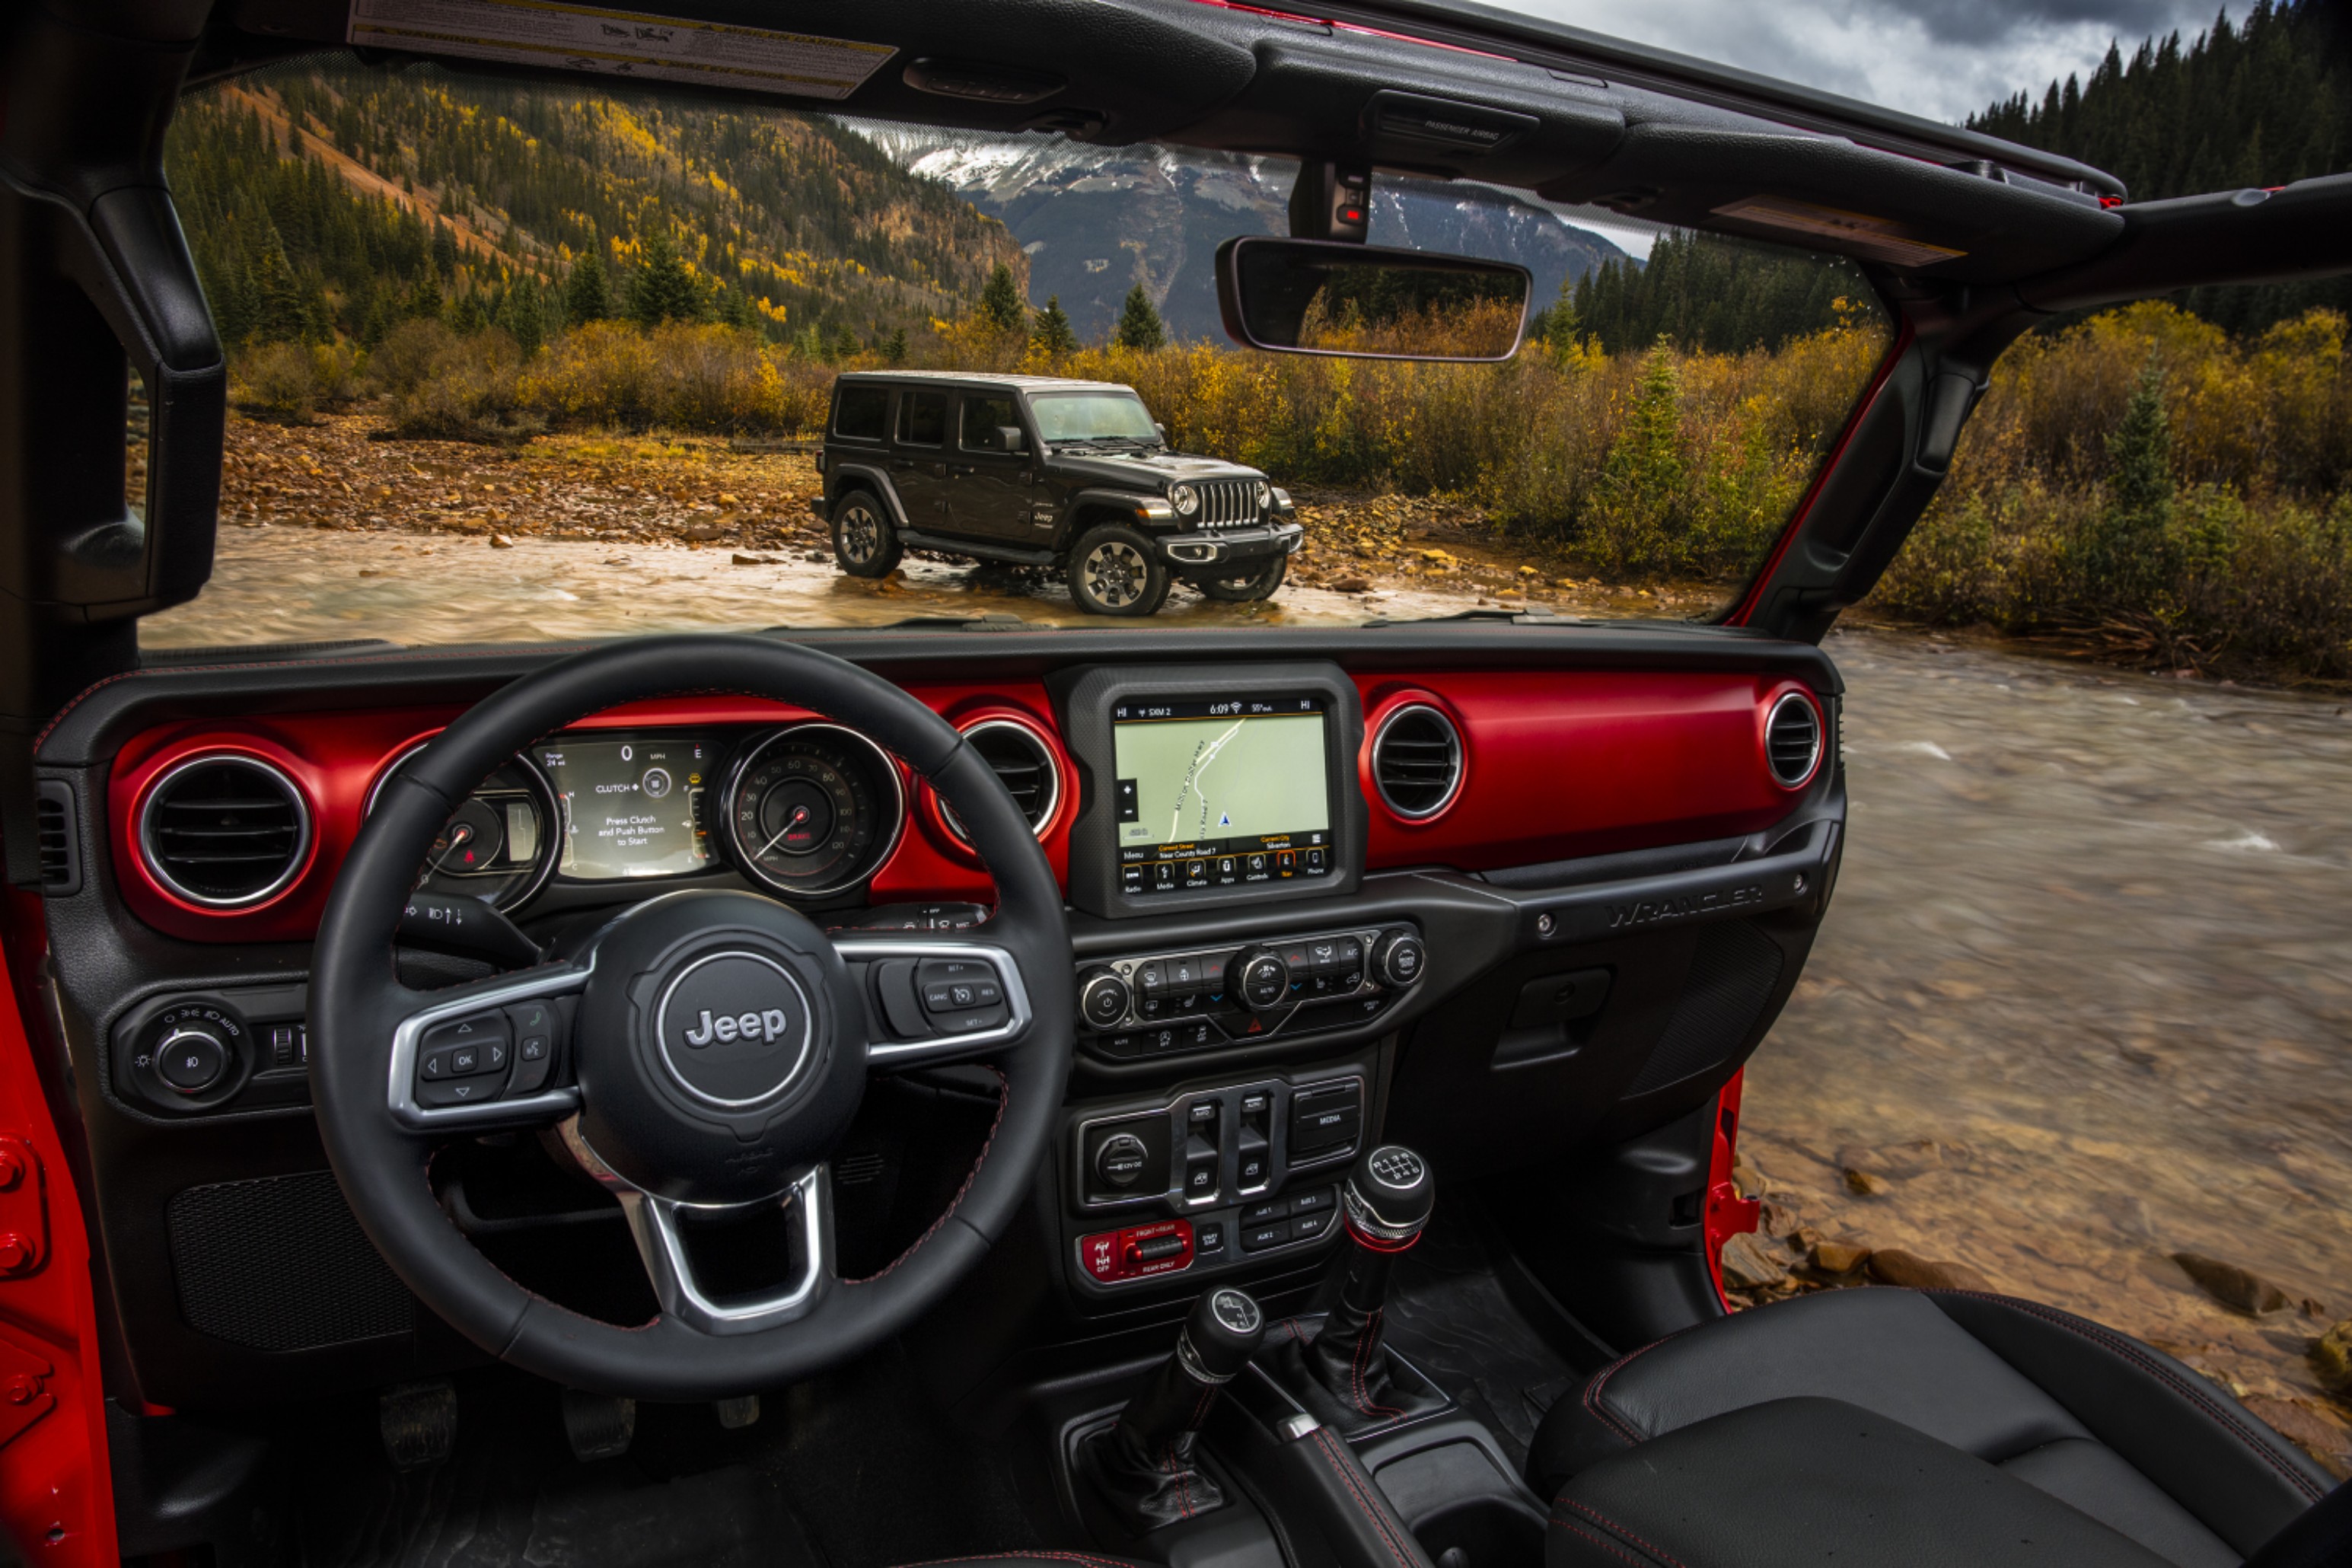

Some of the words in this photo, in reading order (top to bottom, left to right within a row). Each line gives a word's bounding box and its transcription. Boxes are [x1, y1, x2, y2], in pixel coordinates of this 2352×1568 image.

[1425, 120, 1470, 134] PASSENGER
[1471, 129, 1499, 140] AIRBAG
[1209, 703, 1229, 715] 6:09
[1300, 700, 1310, 709] HI
[1117, 706, 1127, 717] HI
[621, 745, 633, 761] 0
[694, 749, 703, 759] E
[754, 776, 767, 785] 40
[823, 773, 835, 782] 80
[596, 785, 630, 793] CLUTCH
[747, 793, 757, 802] 30
[741, 811, 754, 821] 20
[840, 808, 853, 817] 100
[606, 817, 628, 826] Press
[629, 815, 656, 824] Clutch
[598, 828, 614, 837] and
[616, 827, 636, 835] Push
[638, 825, 665, 833] Button
[628, 836, 648, 846] Start
[786, 832, 812, 841] BRAKE
[1123, 851, 1144, 860] Menu
[1174, 850, 1195, 859] County
[1156, 882, 1174, 891] Media
[1605, 884, 1762, 928] WRANGLER
[929, 993, 948, 1001] CANC
[219, 1017, 240, 1036] AUTO
[686, 1009, 787, 1045] Jeep
[458, 1055, 473, 1066] OK
[1319, 1114, 1342, 1126] MEDIA
[1097, 1264, 1110, 1273] OFF
[1143, 1264, 1159, 1273] REAR
[1159, 1260, 1176, 1270] ONLY
